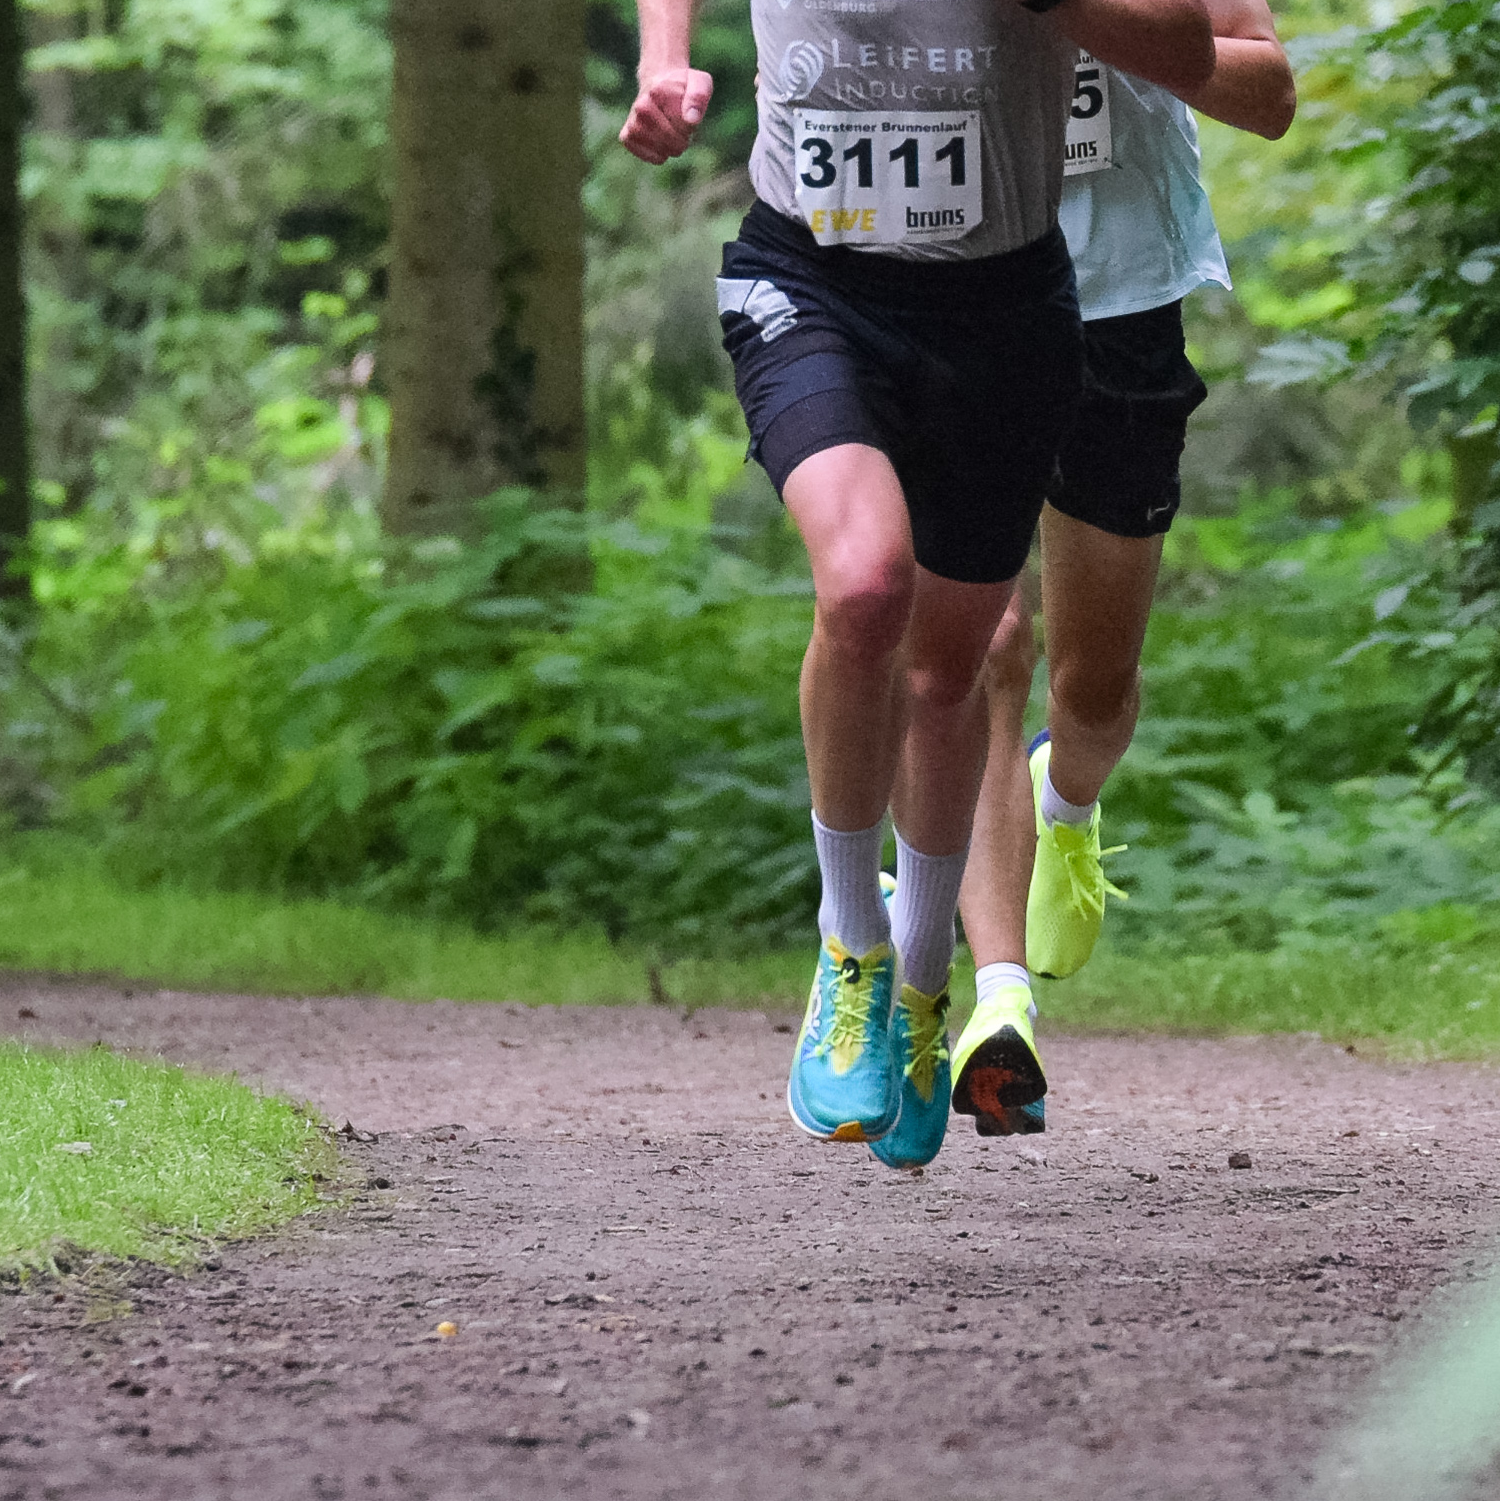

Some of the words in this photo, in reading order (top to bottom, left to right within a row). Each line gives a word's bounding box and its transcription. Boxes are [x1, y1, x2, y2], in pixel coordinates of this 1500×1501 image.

[804, 119, 877, 133] Everstener
[881, 119, 968, 133] Brunnenlauf
[1064, 140, 1098, 160] uns
[800, 136, 966, 189] 3111
[810, 208, 878, 234] EWE
[905, 206, 965, 228] bruns
